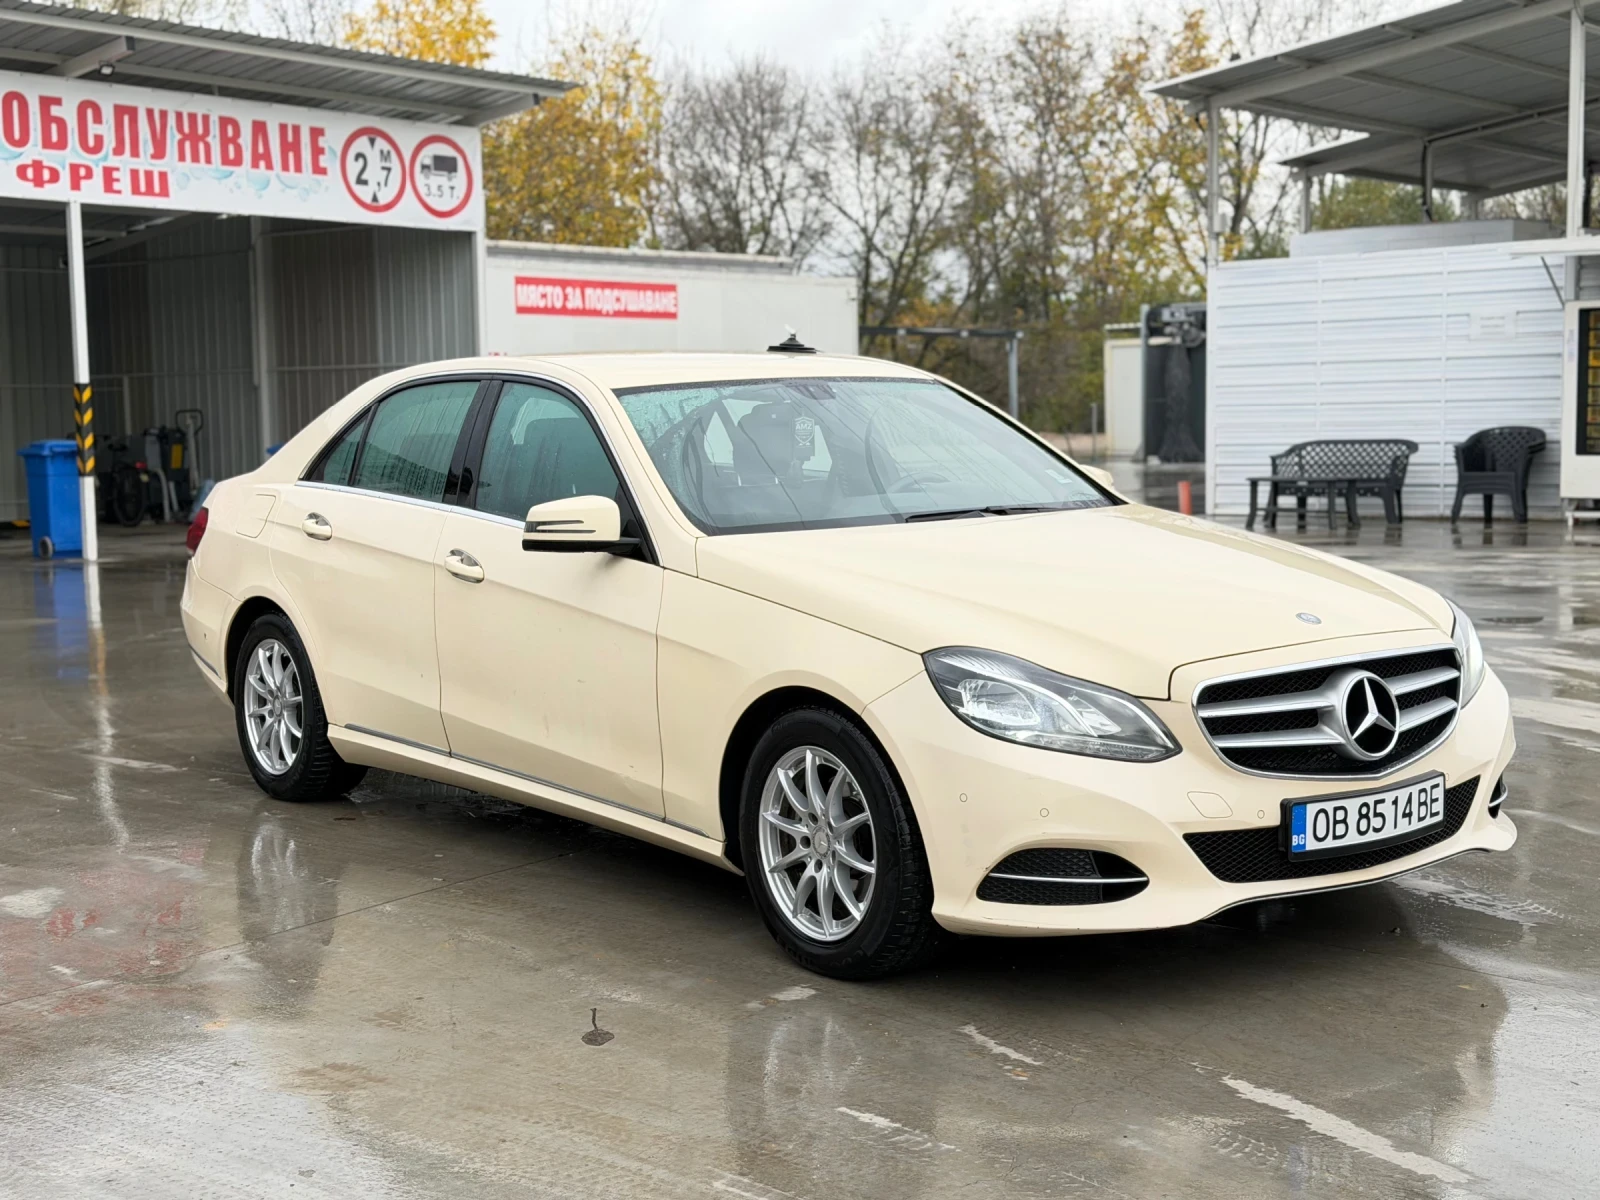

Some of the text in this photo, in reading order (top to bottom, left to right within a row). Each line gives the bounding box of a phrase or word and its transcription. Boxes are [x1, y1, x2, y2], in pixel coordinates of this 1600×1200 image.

[2, 90, 328, 176] ОБСЛУЖВАНЕ
[16, 159, 170, 198] ФРЕШ
[516, 284, 677, 315] МЯСТО ЗА ПОДСУШАВАНЕ
[1312, 783, 1441, 843] OB 8514 BE
[1292, 834, 1305, 846] BG
